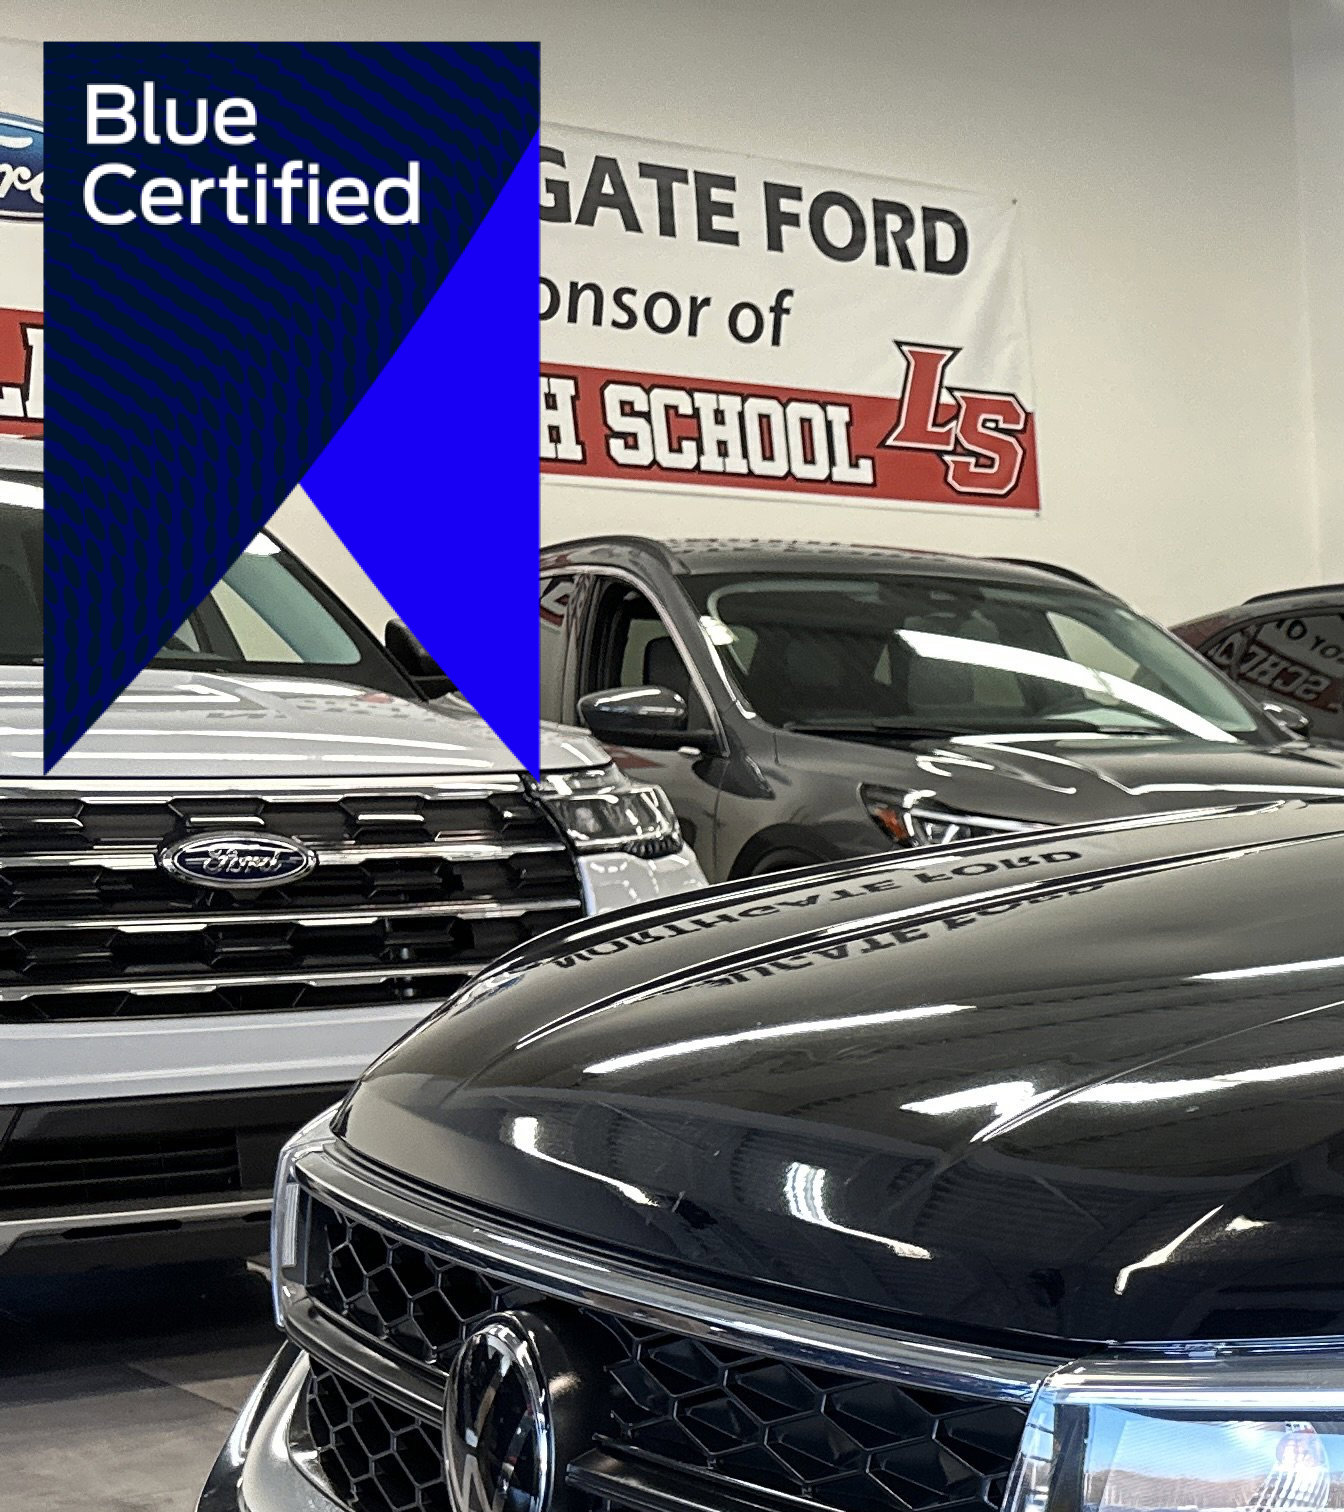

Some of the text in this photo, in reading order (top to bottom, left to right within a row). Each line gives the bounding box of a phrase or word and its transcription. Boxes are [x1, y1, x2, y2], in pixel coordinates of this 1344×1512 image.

[539, 146, 970, 277] GATE FORD
[539, 275, 795, 347] onsor of
[602, 381, 878, 488] SCHOOL
[202, 848, 283, 875] Ford
